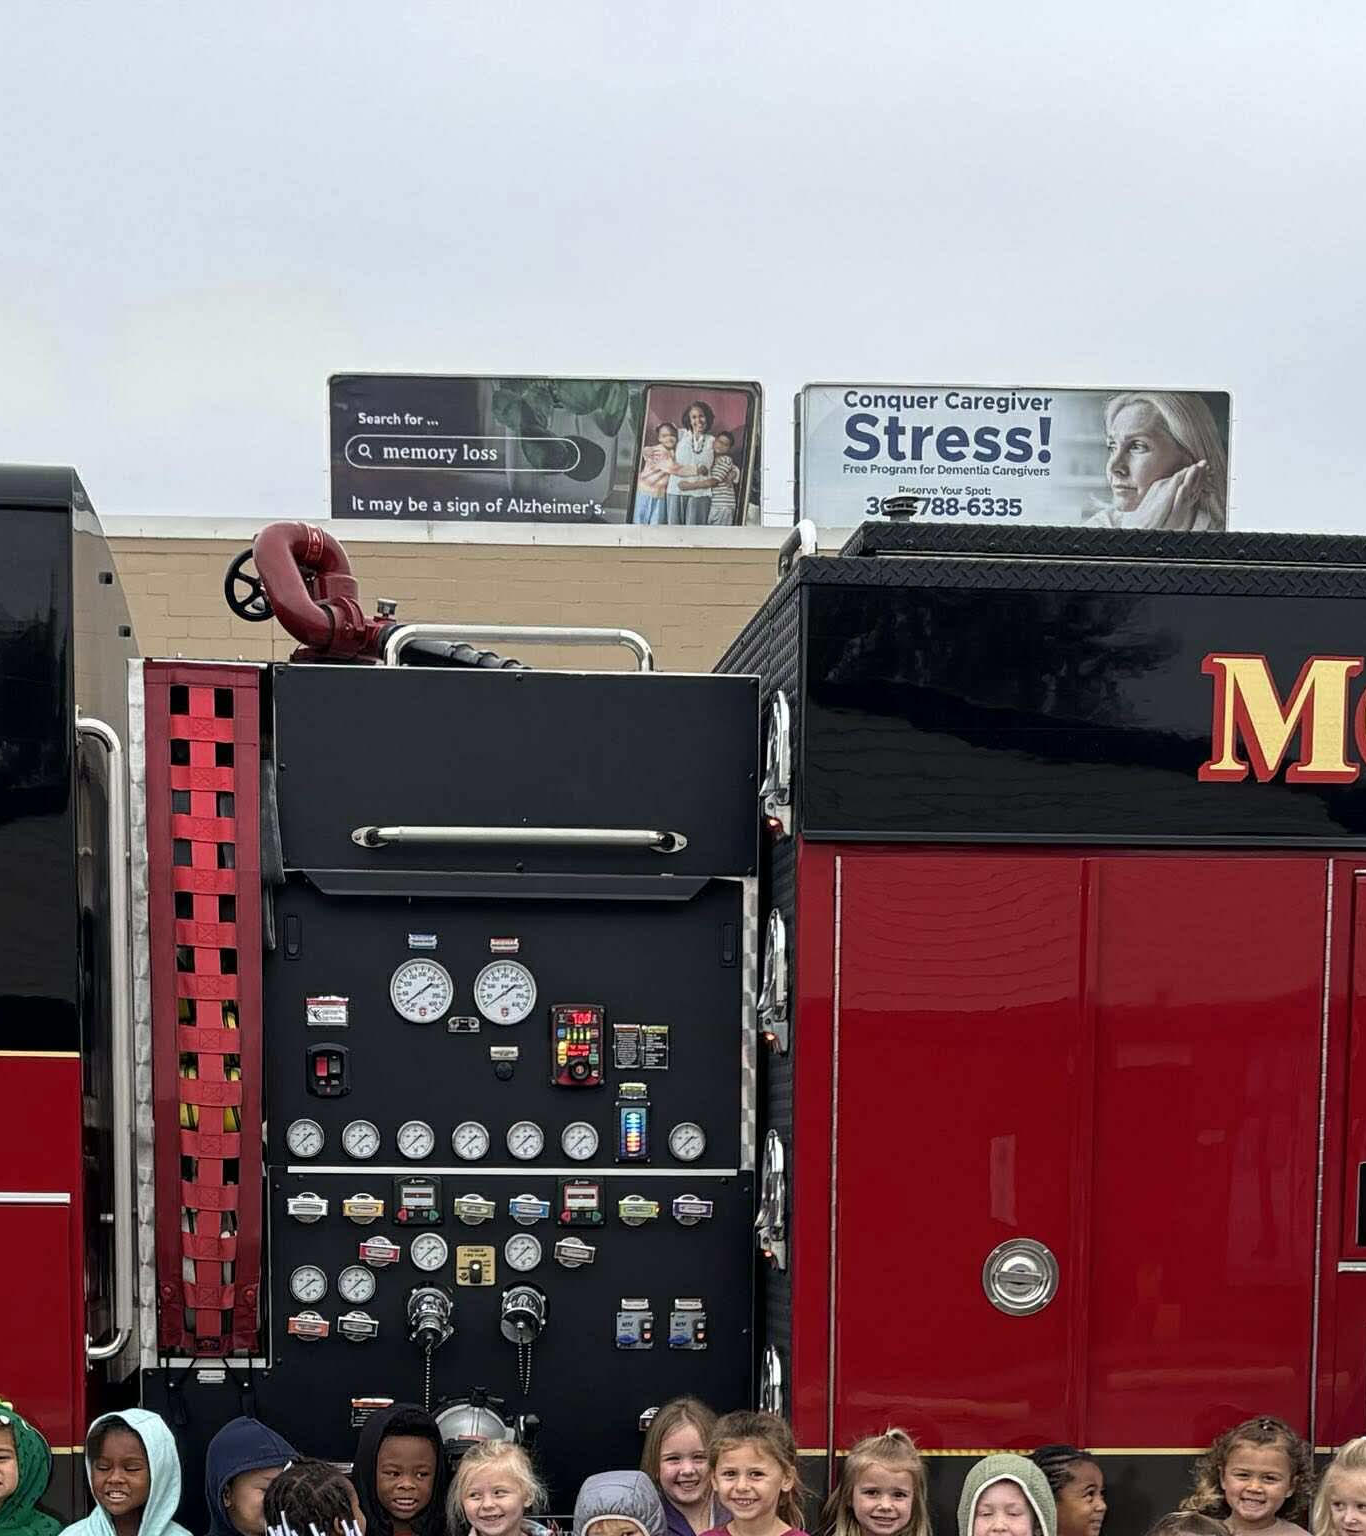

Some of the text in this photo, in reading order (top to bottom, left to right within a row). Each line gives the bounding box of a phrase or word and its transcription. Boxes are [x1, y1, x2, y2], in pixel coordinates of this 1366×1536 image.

[843, 390, 1053, 413] Conquer Caregiver
[358, 411, 401, 425] Search
[404, 413, 424, 425] for
[843, 413, 1052, 463] Stress!
[383, 443, 498, 464] memory loss
[843, 463, 1051, 477] Free Program for Dementia Caregivers
[898, 485, 992, 496] Reserve Your Spot:
[352, 495, 606, 517] It may be a sign of Alzheimer's.
